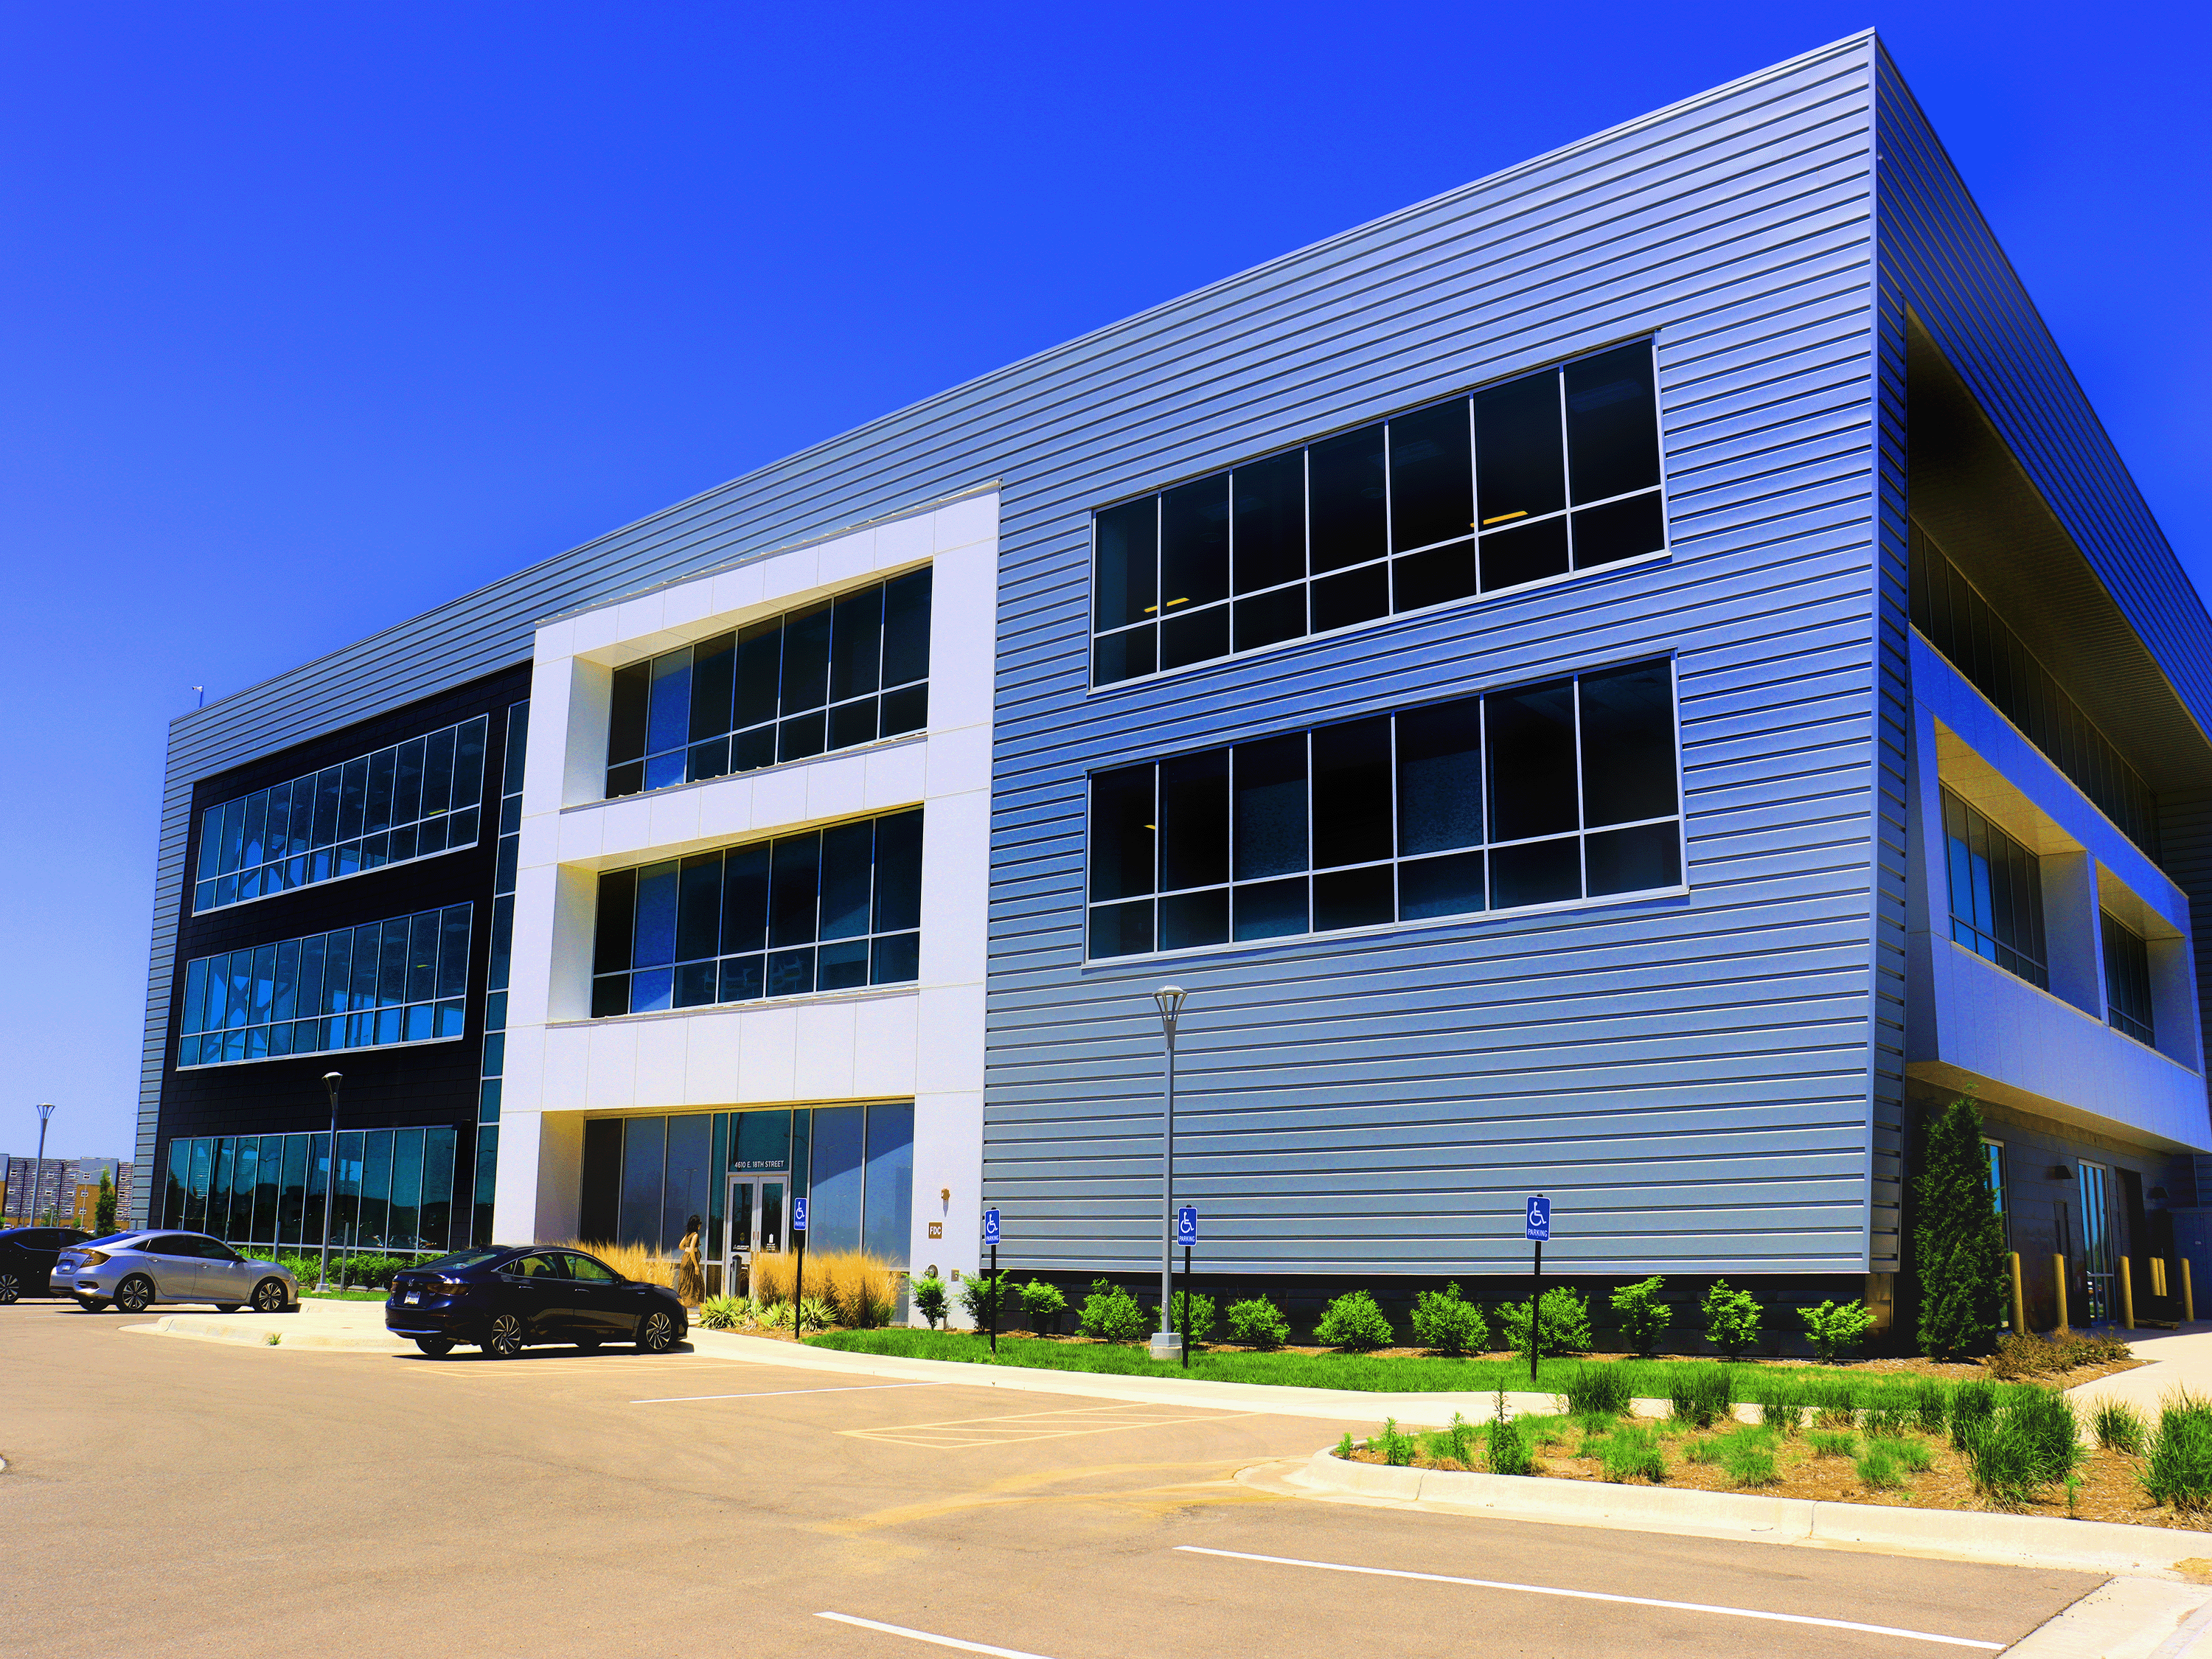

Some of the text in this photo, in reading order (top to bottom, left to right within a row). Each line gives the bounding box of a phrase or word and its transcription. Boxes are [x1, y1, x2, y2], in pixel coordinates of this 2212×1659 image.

[765, 1160, 785, 1168] STREET
[929, 1225, 942, 1235] FDC
[1527, 1228, 1548, 1238] PARKING
